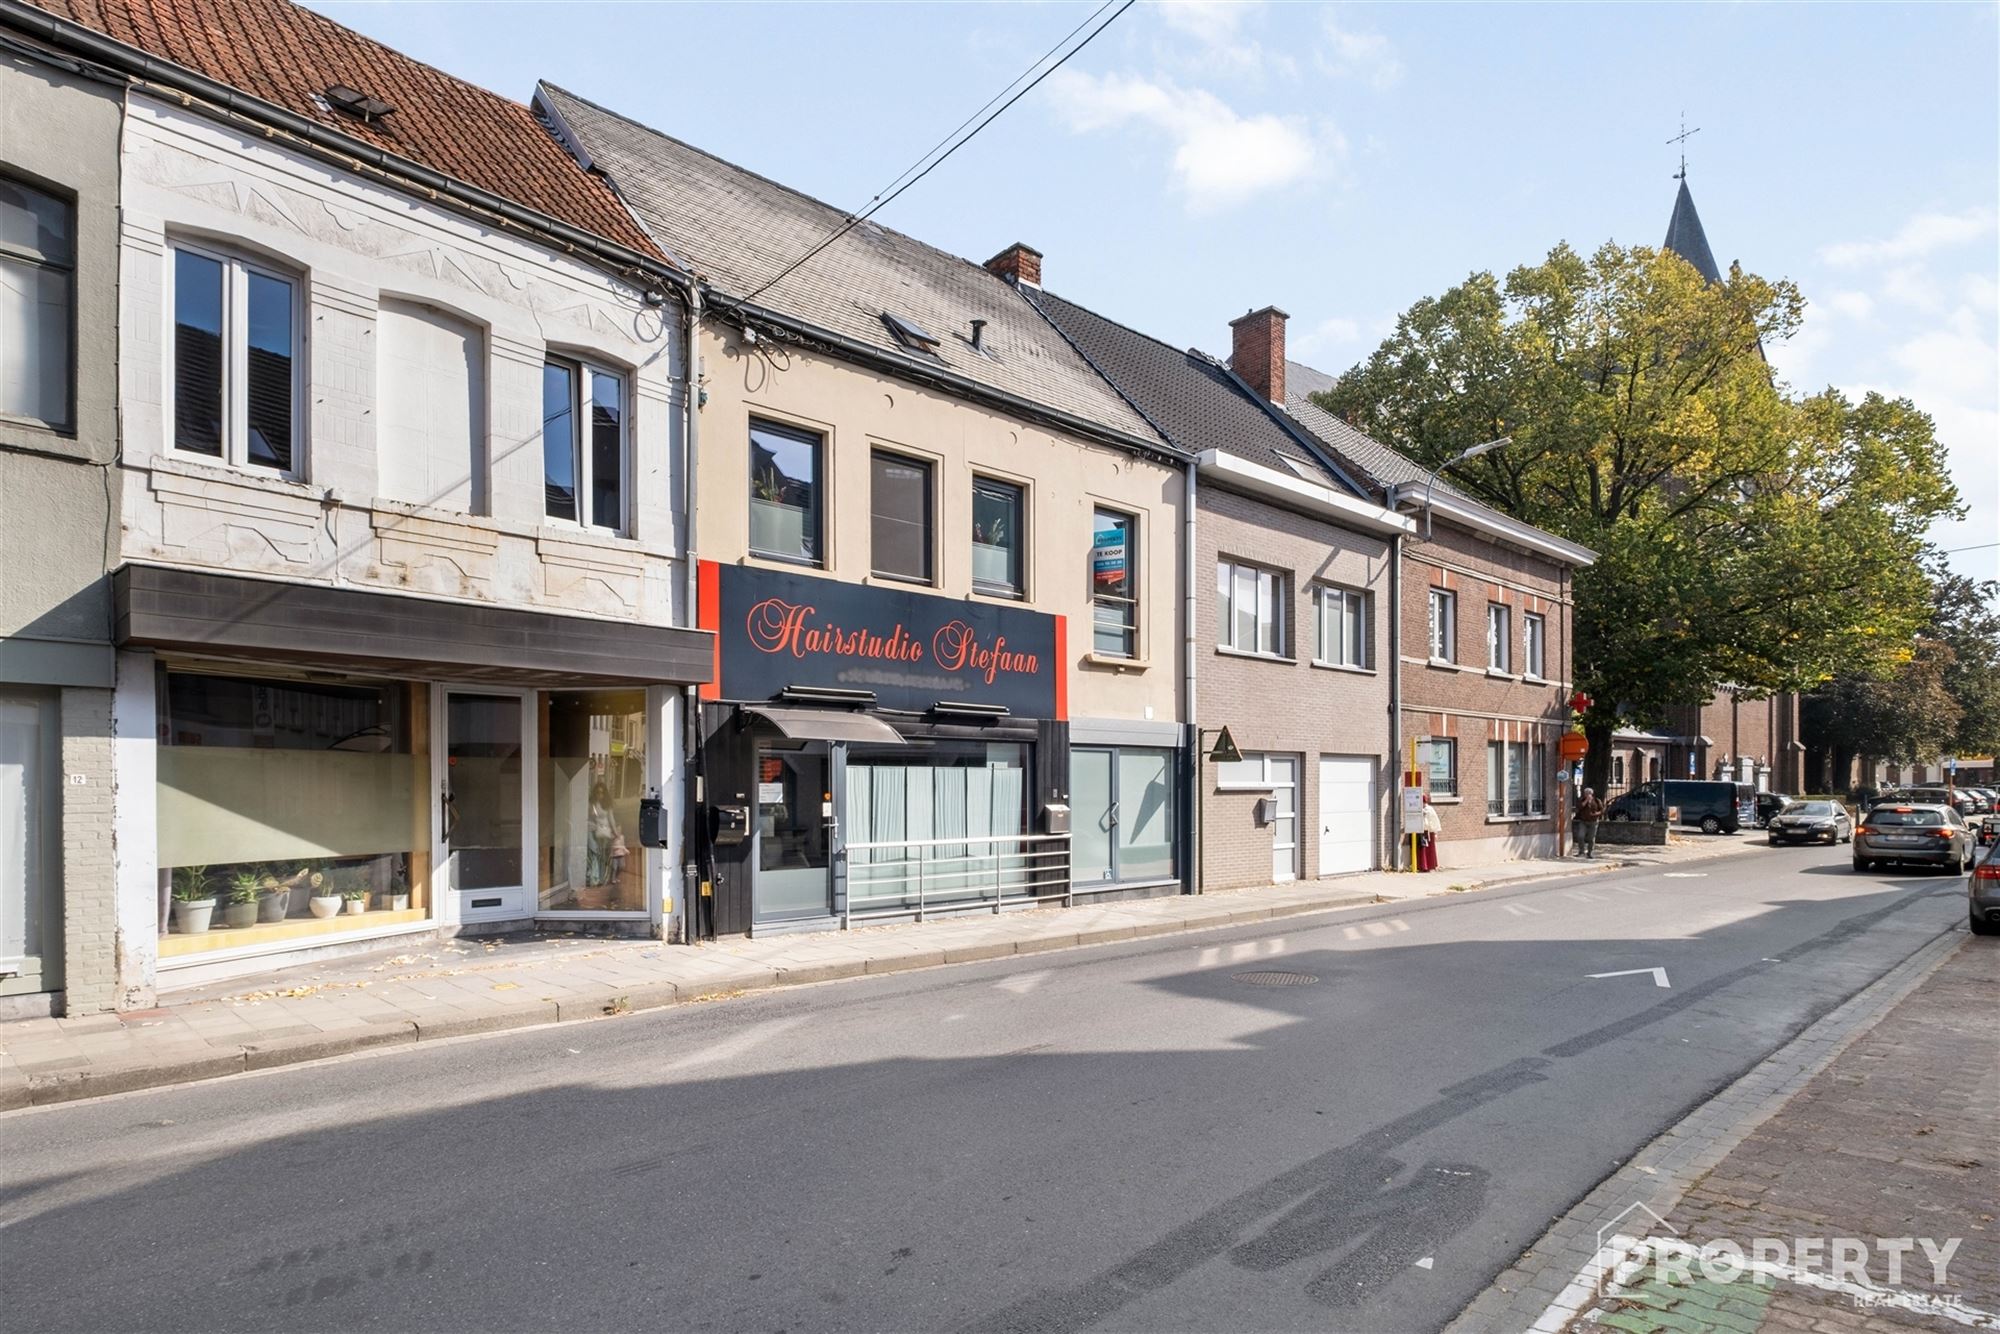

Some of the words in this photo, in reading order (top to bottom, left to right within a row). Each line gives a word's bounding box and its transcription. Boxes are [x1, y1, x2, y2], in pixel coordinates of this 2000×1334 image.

[746, 597, 923, 662] Hairstudio
[932, 619, 1038, 685] Stefaan
[73, 776, 82, 784] 12
